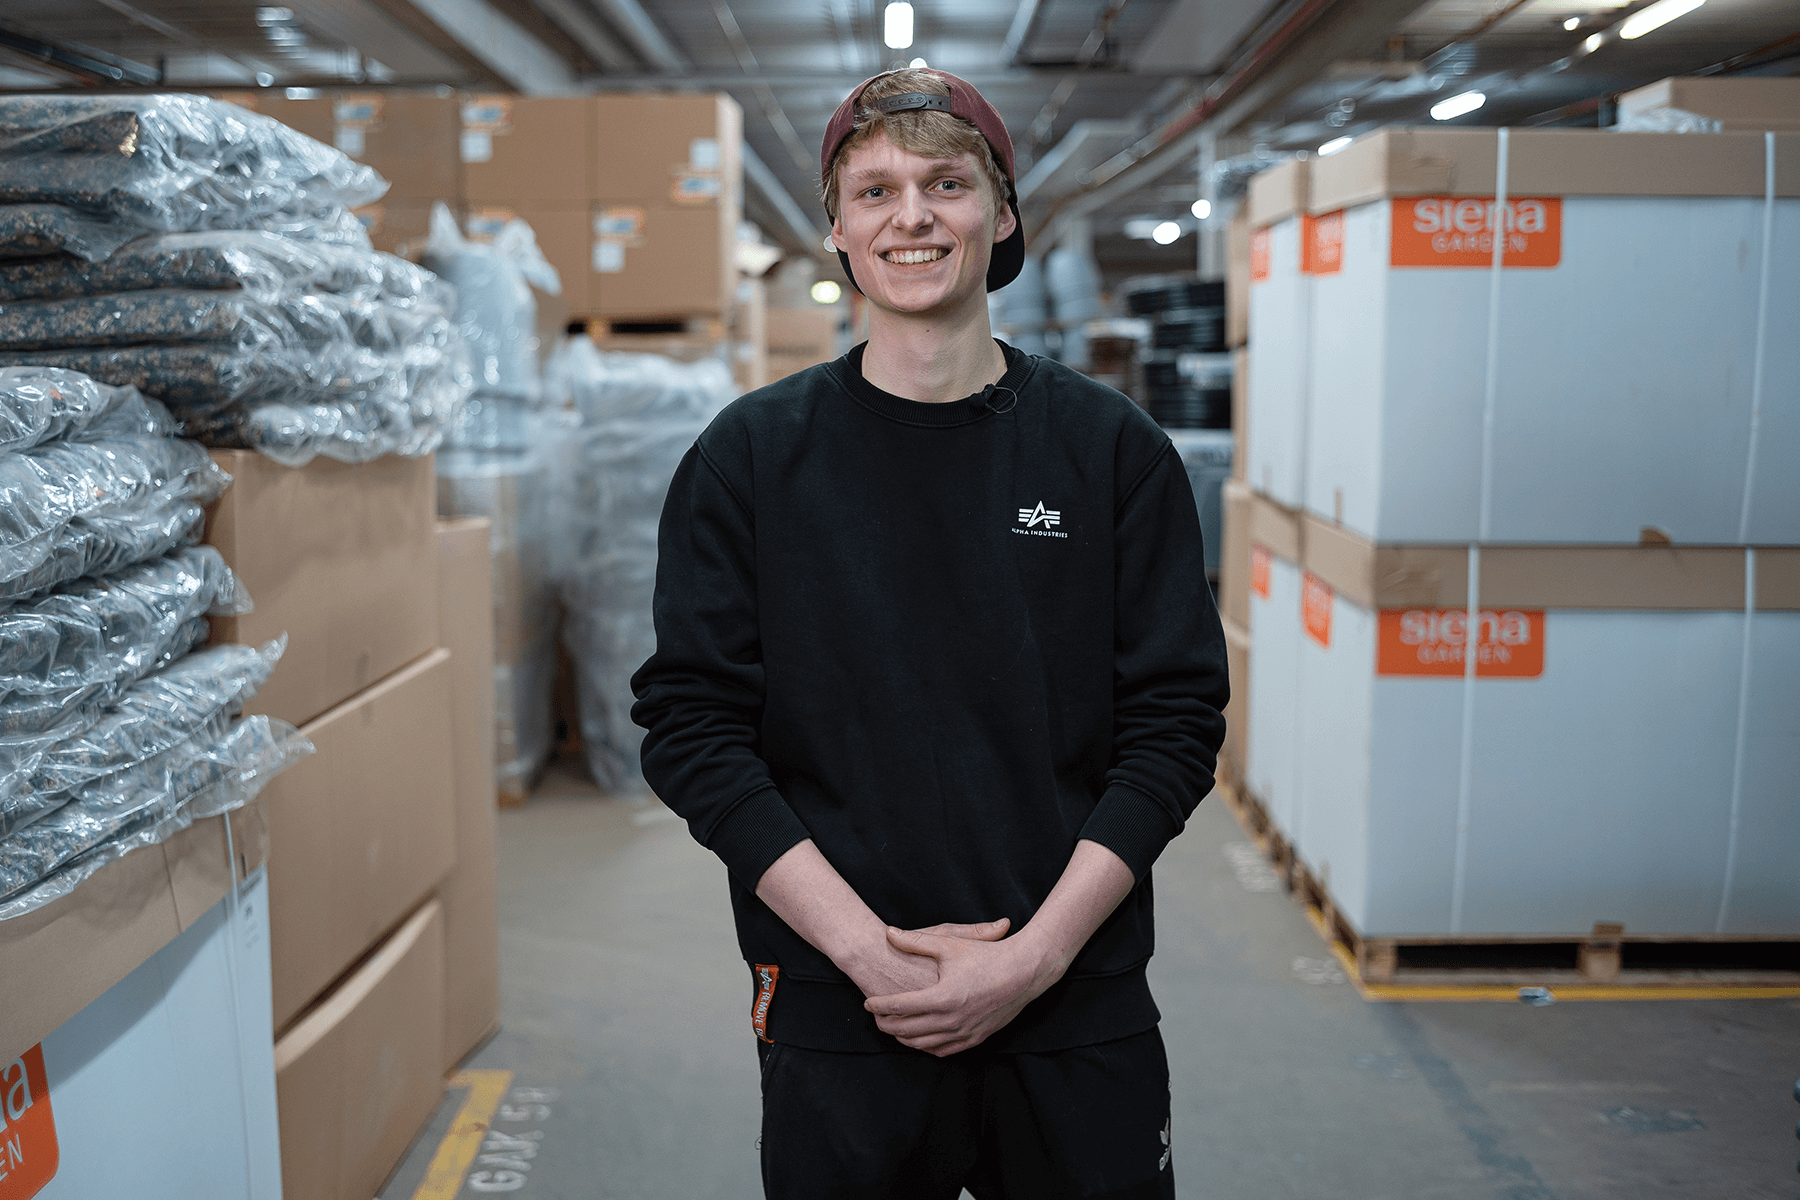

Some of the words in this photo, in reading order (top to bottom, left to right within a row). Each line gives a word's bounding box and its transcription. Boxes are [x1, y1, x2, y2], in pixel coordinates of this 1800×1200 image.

[1413, 199, 1547, 233] siena
[1030, 530, 1068, 539] INDUSTRIES
[1399, 610, 1531, 646] siena
[1417, 643, 1513, 664] GAREN
[755, 991, 771, 1026] REMOVE
